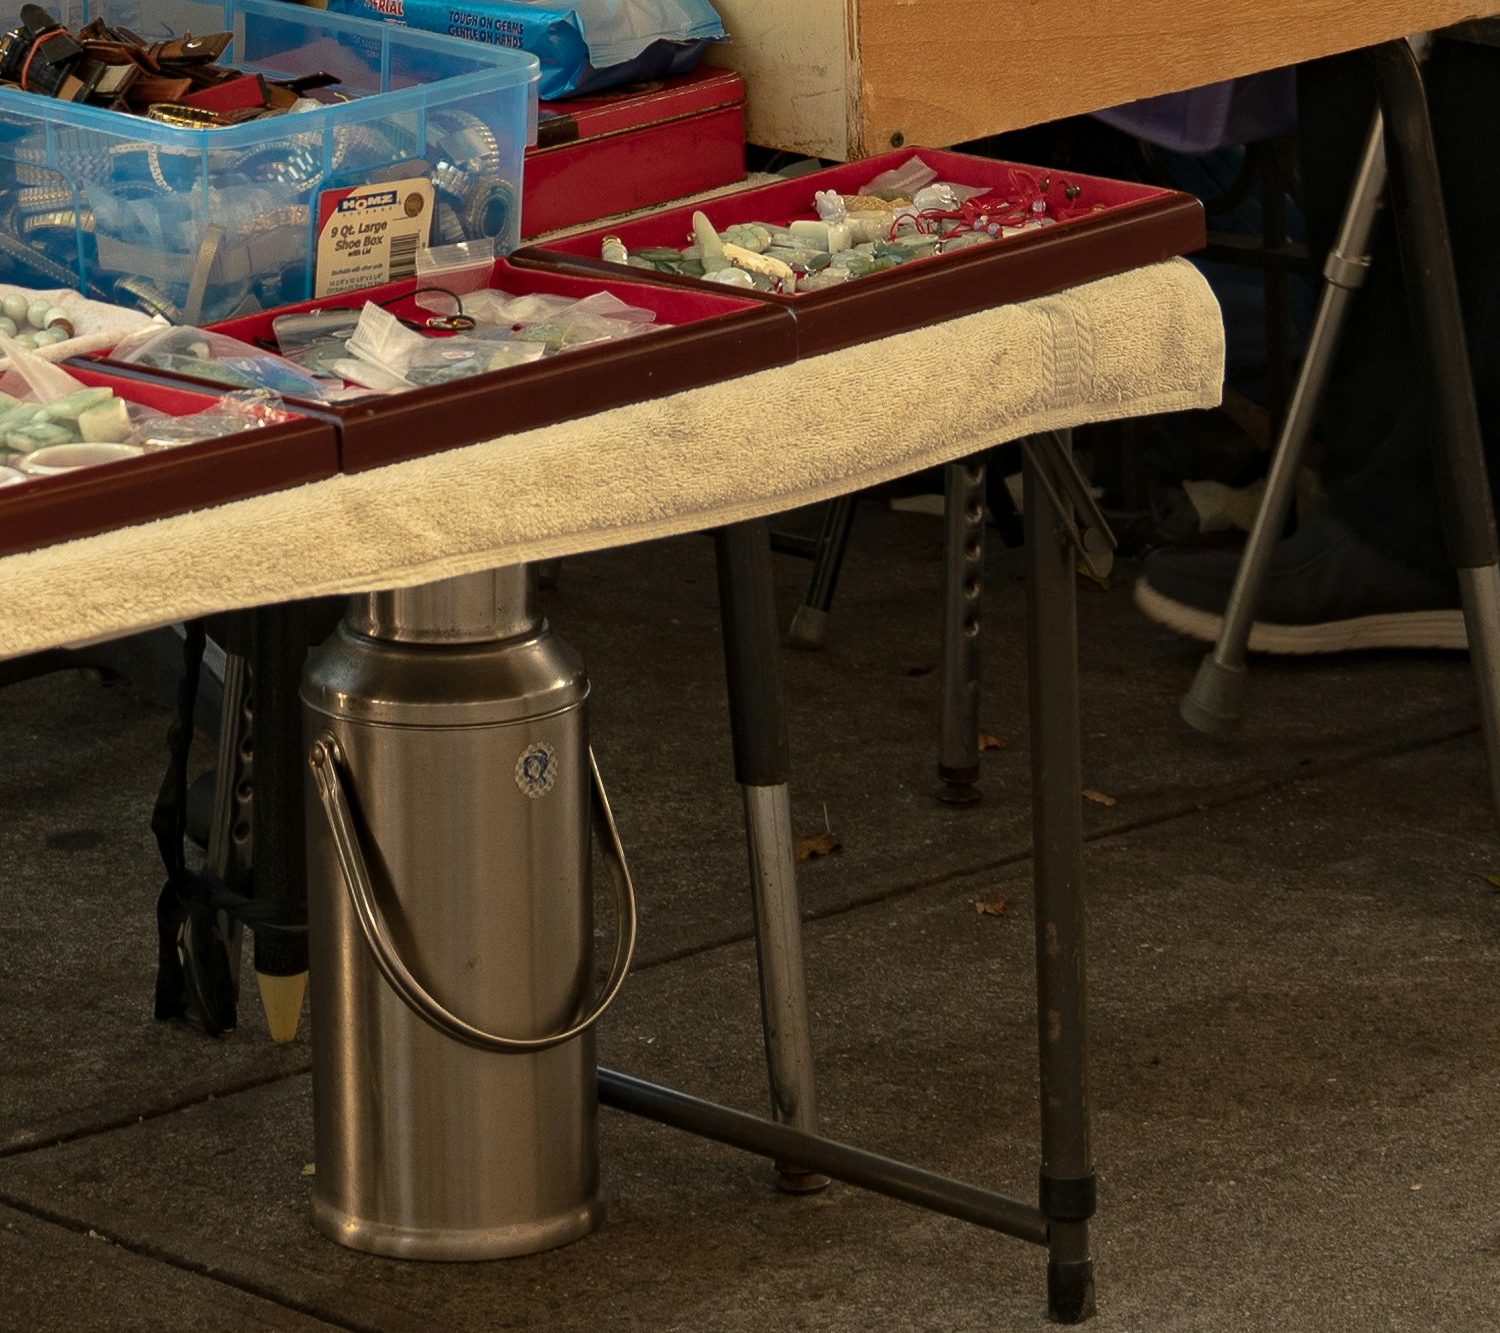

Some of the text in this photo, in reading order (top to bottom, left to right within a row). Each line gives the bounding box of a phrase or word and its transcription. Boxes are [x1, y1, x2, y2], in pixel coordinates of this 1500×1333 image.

[449, 10, 524, 35] TOUGH ON GERMS
[448, 26, 478, 42] GENTLE
[479, 29, 494, 44] ON
[342, 193, 394, 211] HOMZ
[330, 221, 388, 238] 9 Qt. Large
[335, 235, 384, 252] Shoe Box
